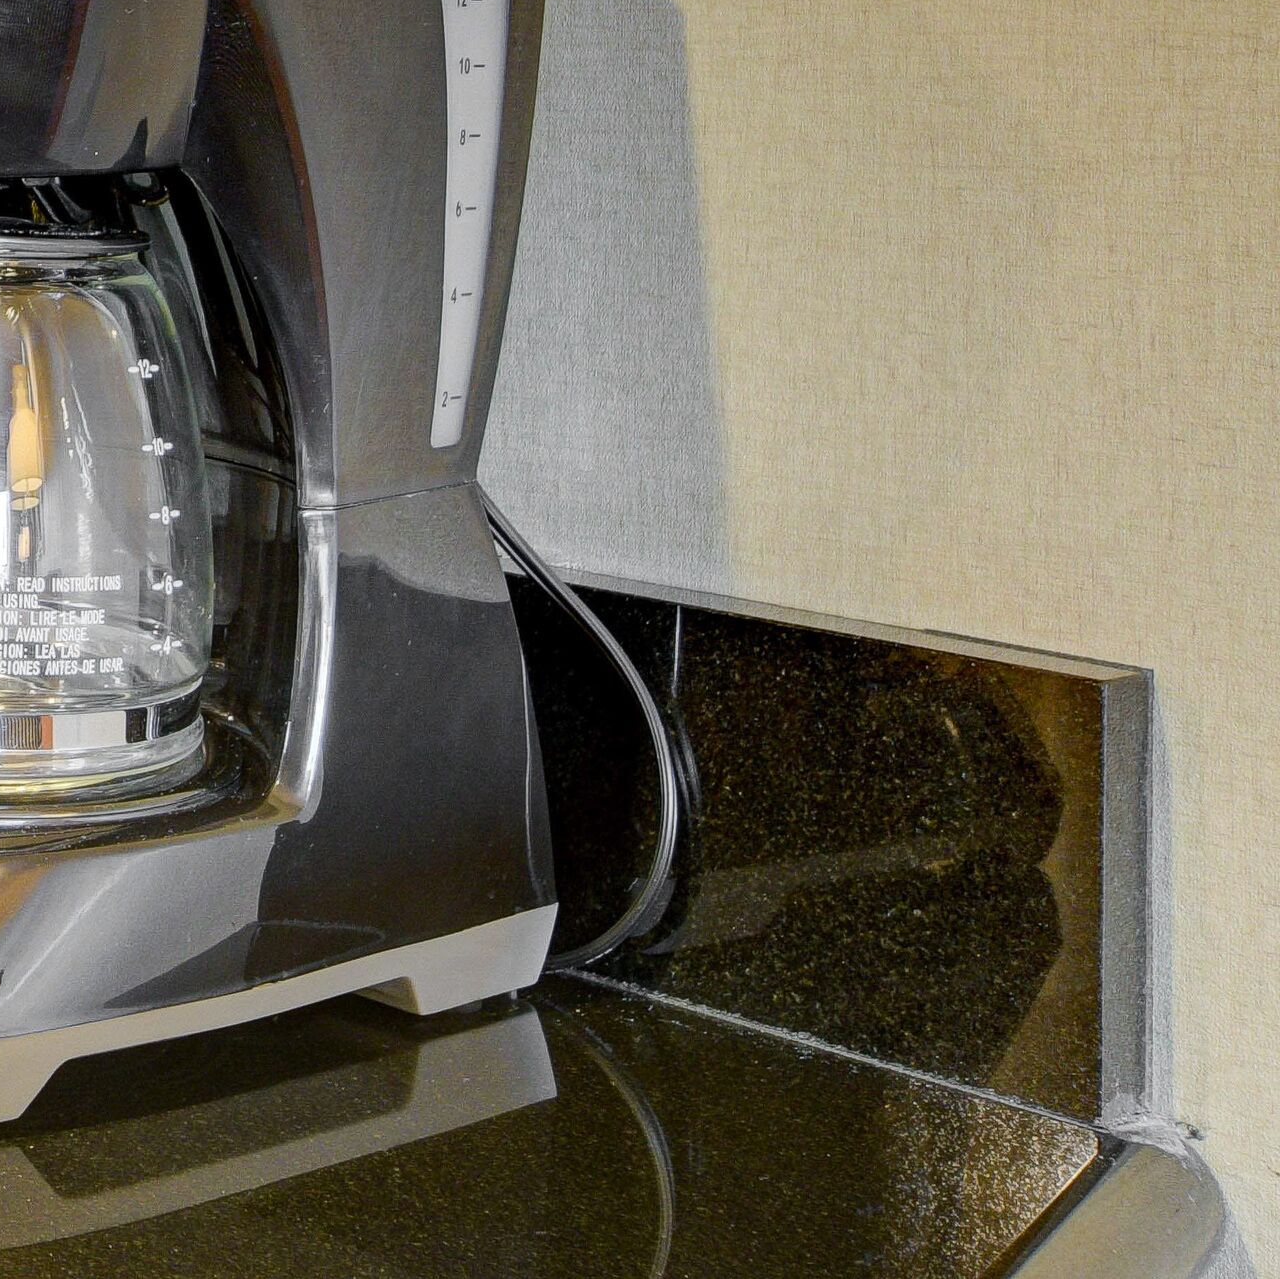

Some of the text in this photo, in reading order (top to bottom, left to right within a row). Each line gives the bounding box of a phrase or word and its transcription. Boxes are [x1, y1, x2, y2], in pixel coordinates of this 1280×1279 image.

[459, 57, 471, 74] 10
[459, 129, 466, 146] 8
[456, 201, 462, 218] 6
[451, 287, 457, 304] 4
[137, 359, 152, 378] 12
[441, 391, 448, 408] 2
[152, 437, 165, 456] 10
[161, 505, 169, 525] 8
[17, 577, 45, 592] READ
[52, 575, 122, 592] INSTRUCTIONS
[165, 575, 173, 595] 6
[30, 611, 57, 625] LIRE
[62, 611, 76, 625] LE
[80, 609, 105, 624] MODE
[16, 627, 50, 642] AVANT
[35, 644, 56, 659] LEA
[61, 643, 81, 658] LAS
[163, 635, 171, 655] 4
[45, 660, 77, 675] ANTES
[83, 658, 96, 674] DE
